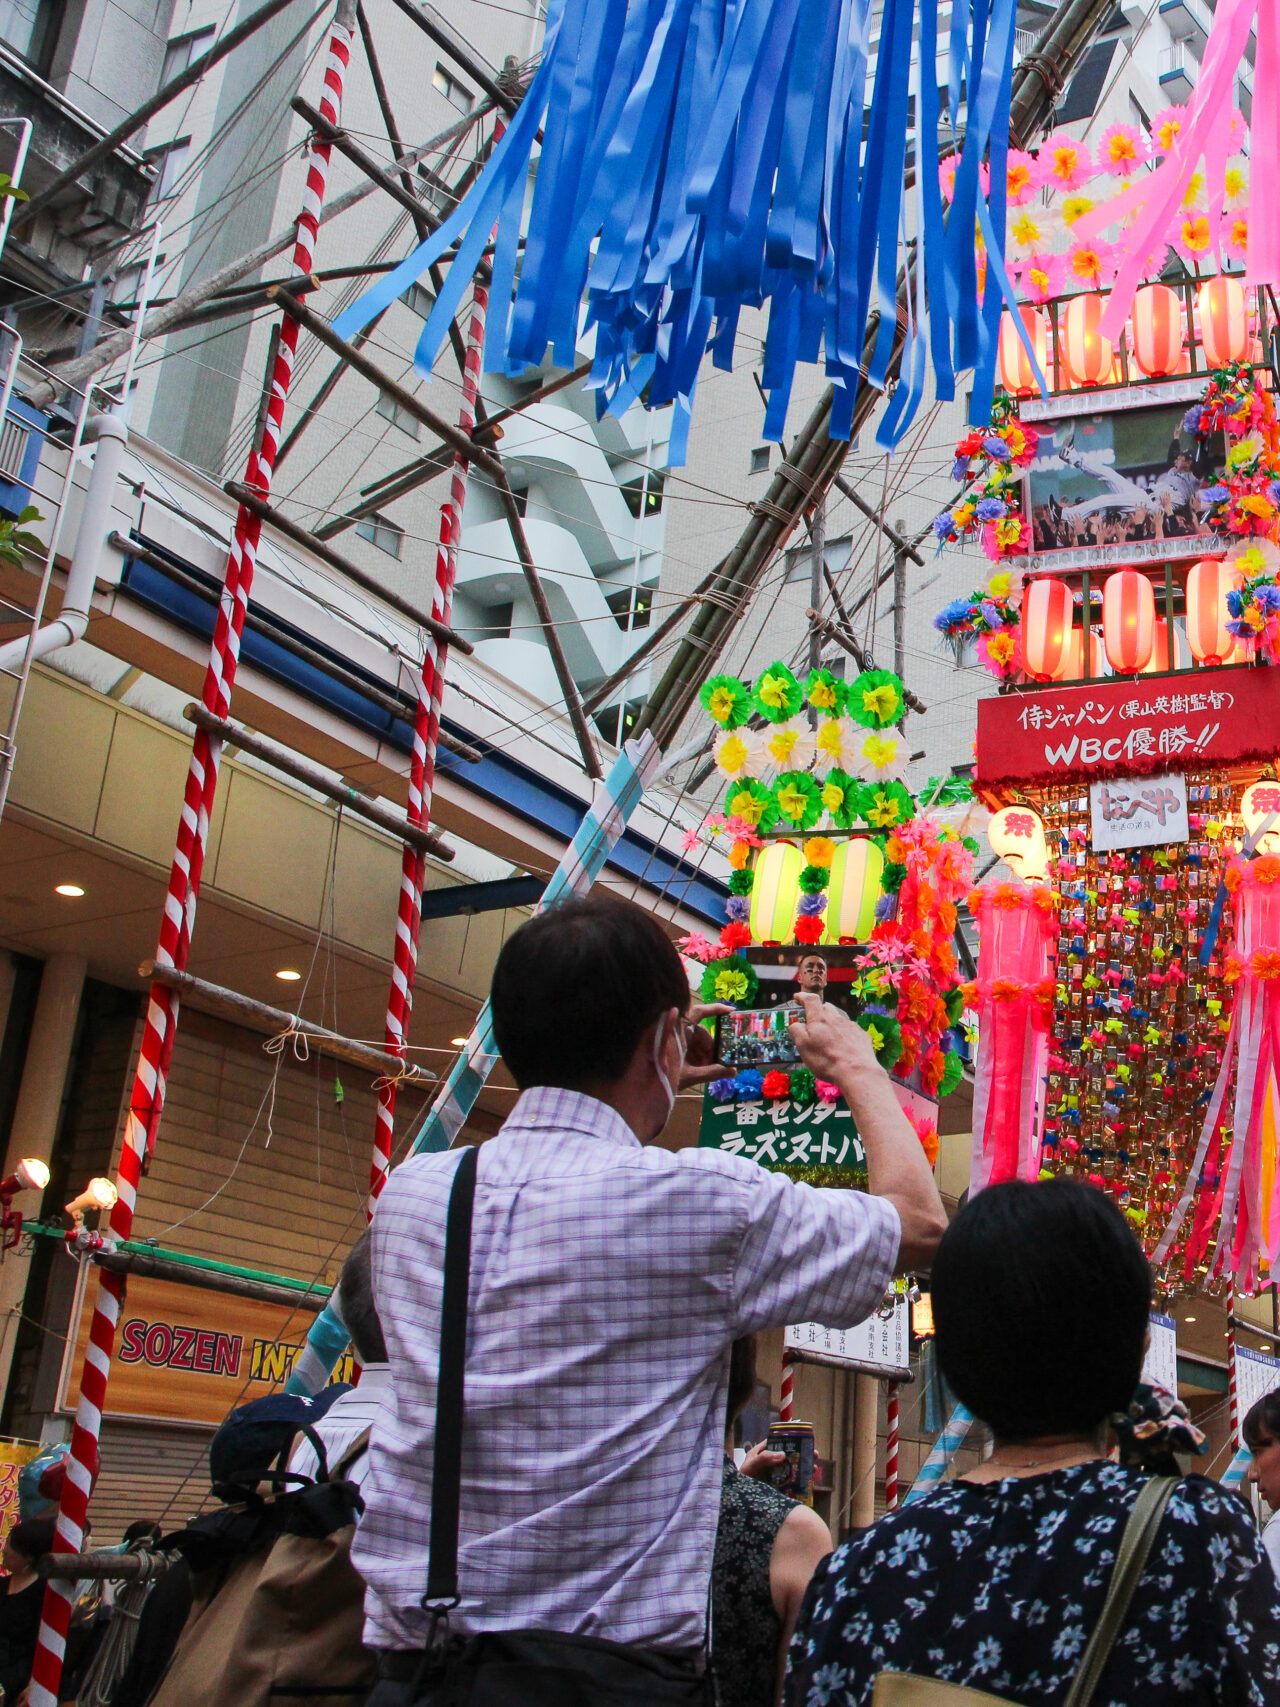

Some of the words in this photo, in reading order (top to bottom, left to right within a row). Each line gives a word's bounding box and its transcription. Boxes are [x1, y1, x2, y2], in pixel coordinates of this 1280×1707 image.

[1044, 722, 1220, 766] WBC優勝!!
[1004, 812, 1035, 838] 祭
[1097, 788, 1180, 827] なべや
[712, 1101, 852, 1125] 一番センター
[719, 1129, 866, 1164] ラーズ・ヌートバ
[119, 1318, 243, 1378] SOZEN
